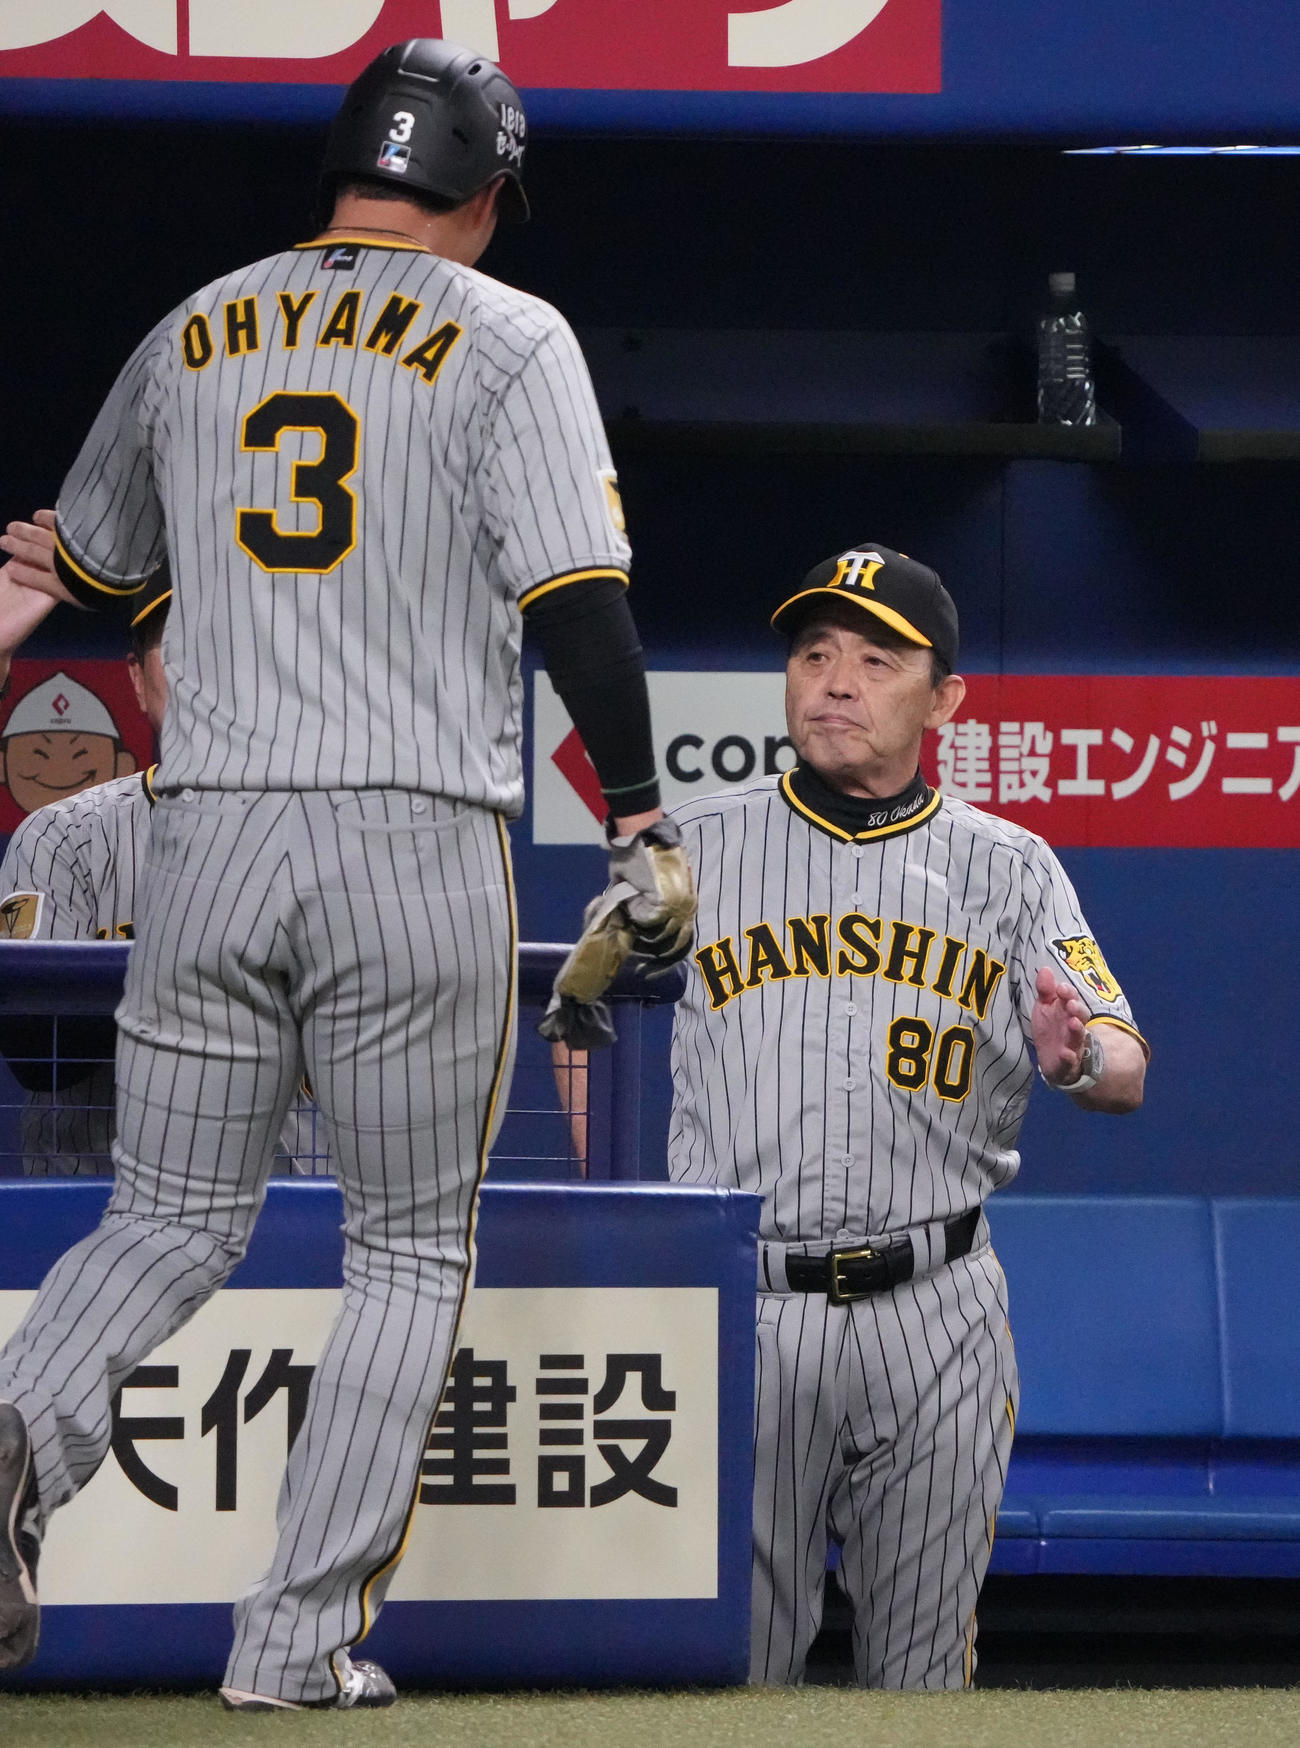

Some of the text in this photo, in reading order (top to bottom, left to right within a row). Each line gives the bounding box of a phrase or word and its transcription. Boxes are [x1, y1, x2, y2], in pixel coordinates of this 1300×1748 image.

[388, 111, 415, 142] 3
[181, 289, 464, 386] OHYAMA
[235, 390, 361, 575] 3
[695, 912, 1006, 1021] HANSHIN
[886, 1016, 976, 1103] 80
